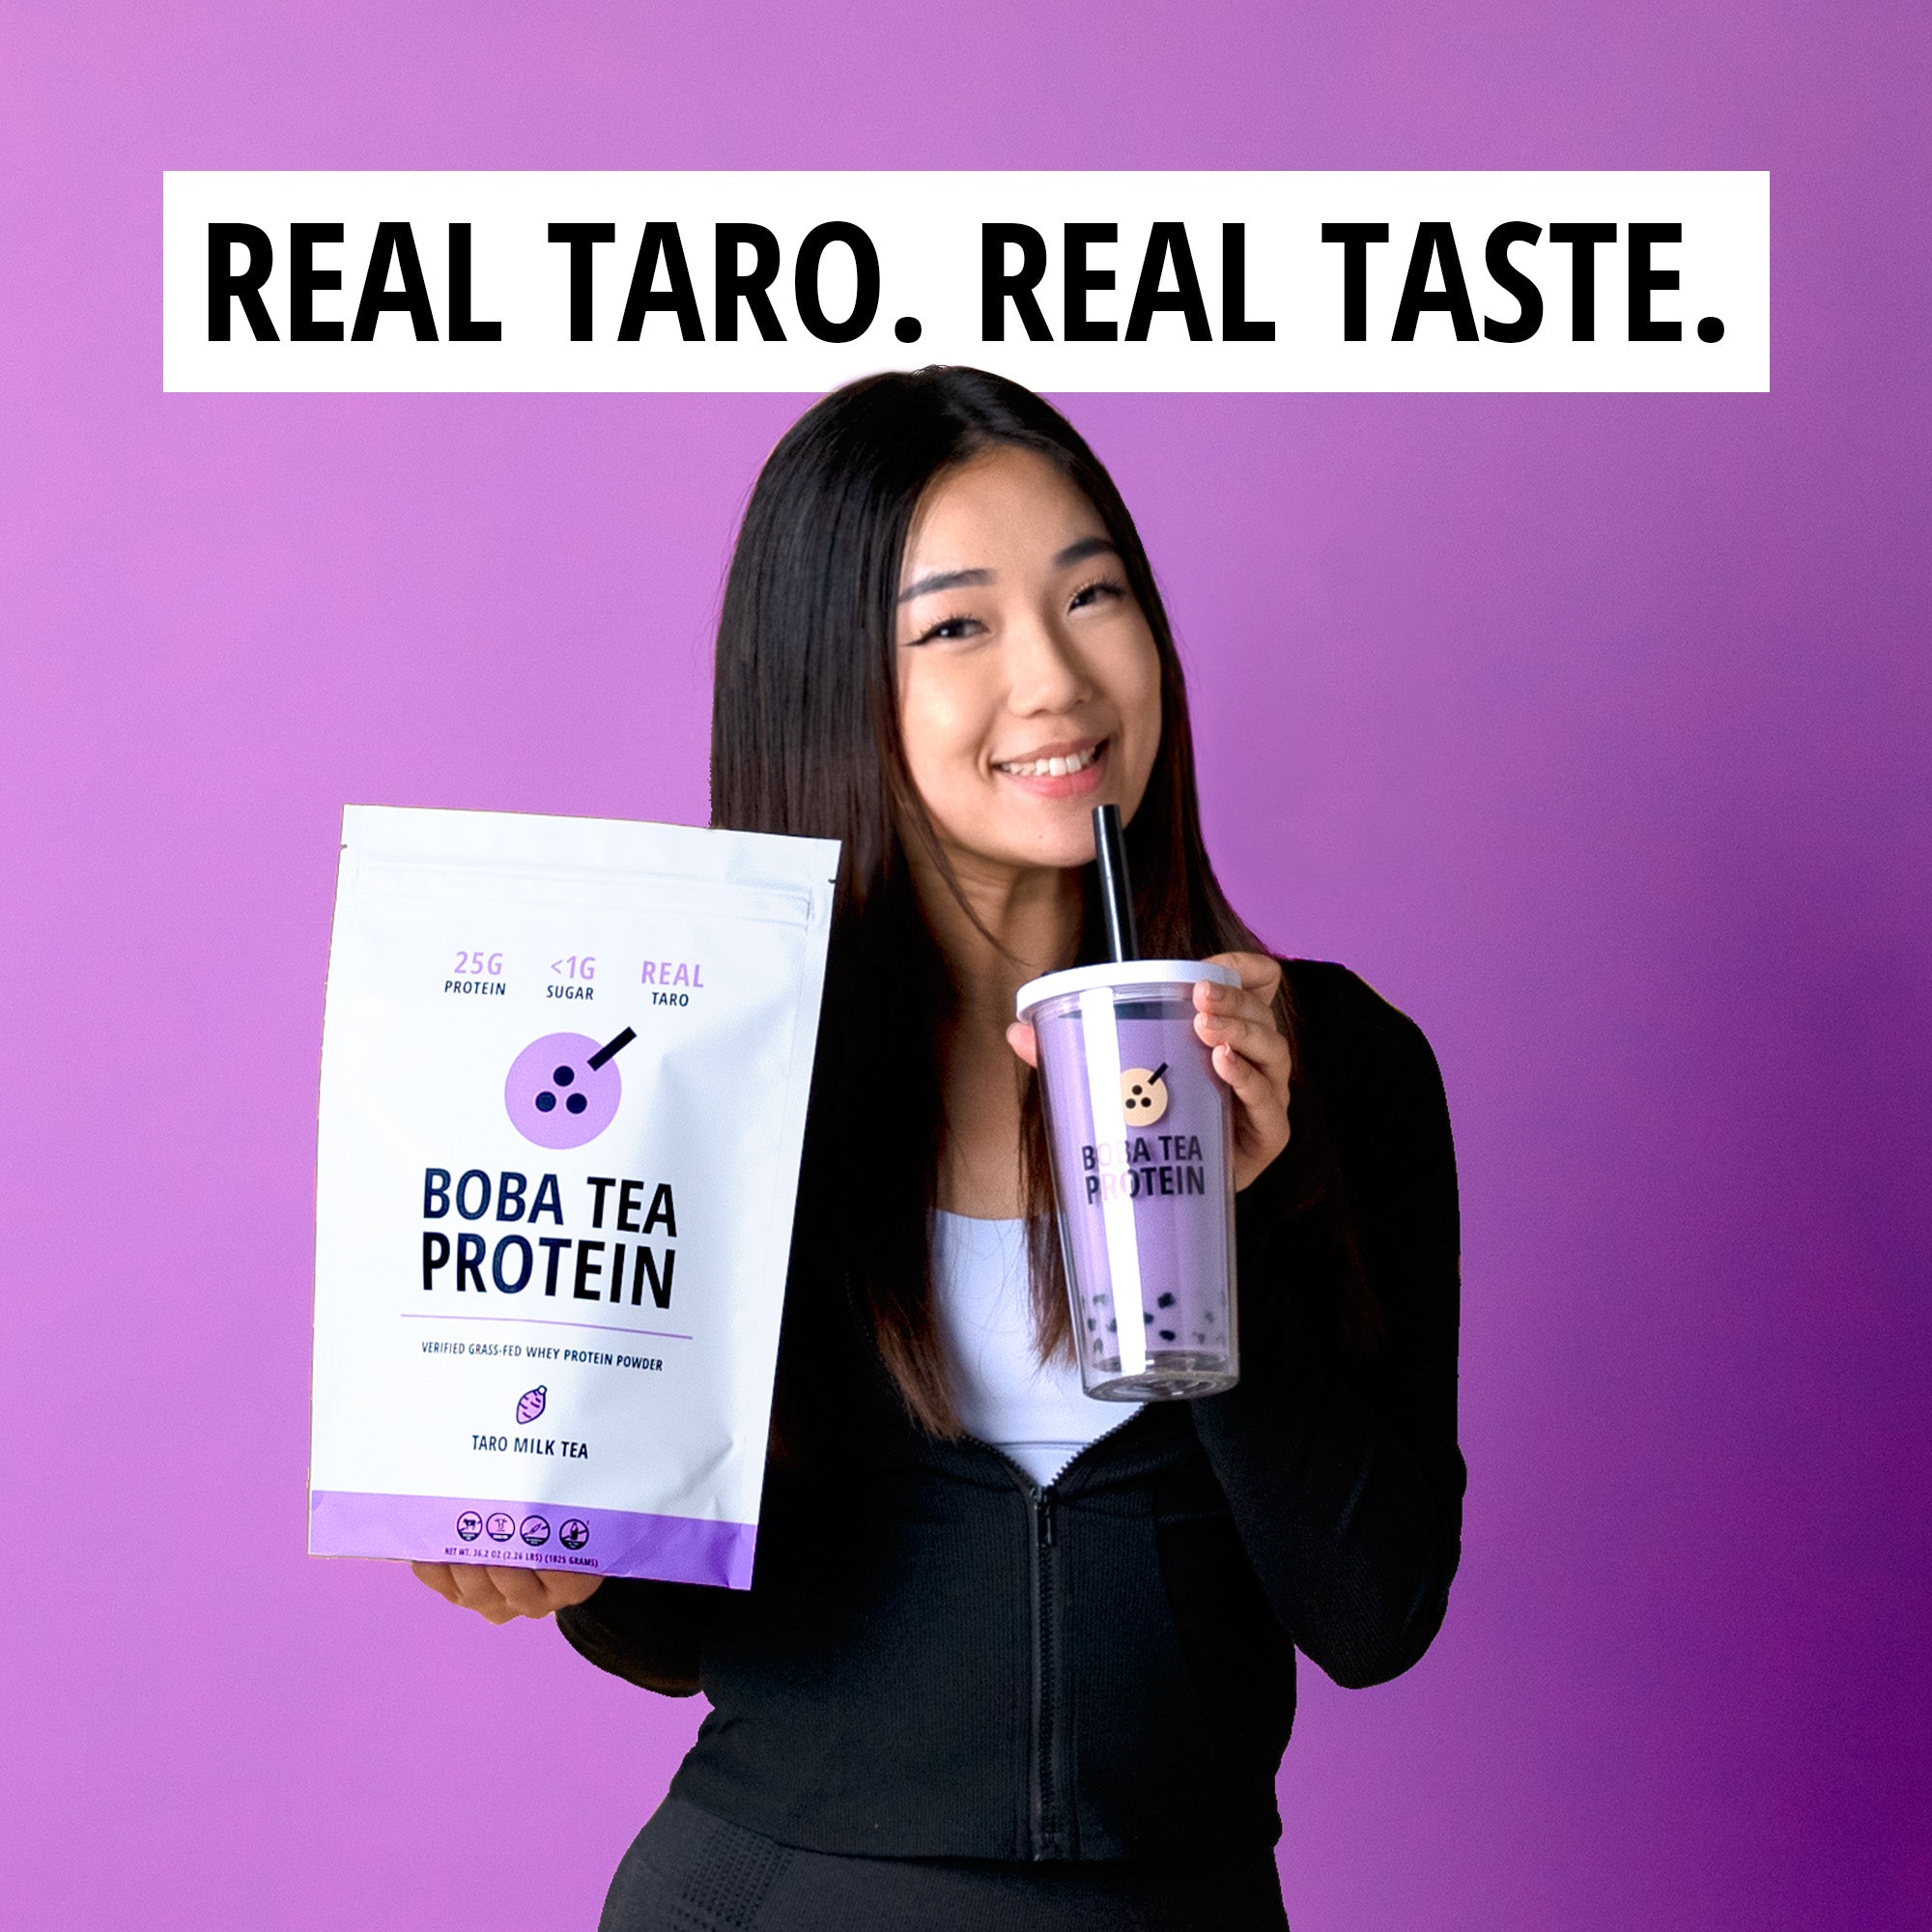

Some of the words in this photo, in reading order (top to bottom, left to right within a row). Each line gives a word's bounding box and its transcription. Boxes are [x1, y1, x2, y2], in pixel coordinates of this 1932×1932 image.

[454, 951, 503, 976] 25G
[551, 955, 596, 980] <1G
[640, 960, 704, 987] REAL
[444, 980, 506, 995] PROTEIN
[546, 985, 594, 1000] SUGAR
[651, 992, 689, 1007] TARO
[1158, 1135, 1203, 1161] TEA
[423, 1168, 564, 1225] BOBA
[587, 1177, 677, 1237] TEA
[423, 1232, 676, 1309] PROTEIN
[421, 1341, 465, 1354] VERIFIED
[469, 1344, 522, 1356] GRASS-FED
[526, 1347, 559, 1360] WHEY
[564, 1350, 612, 1365] PROTEIN
[616, 1355, 663, 1371] POWDER
[472, 1435, 508, 1451] TARO
[514, 1437, 555, 1456] MILK
[561, 1441, 588, 1459] TEA
[526, 1552, 543, 1562] LBS)
[569, 1556, 599, 1568] GRAMS)
